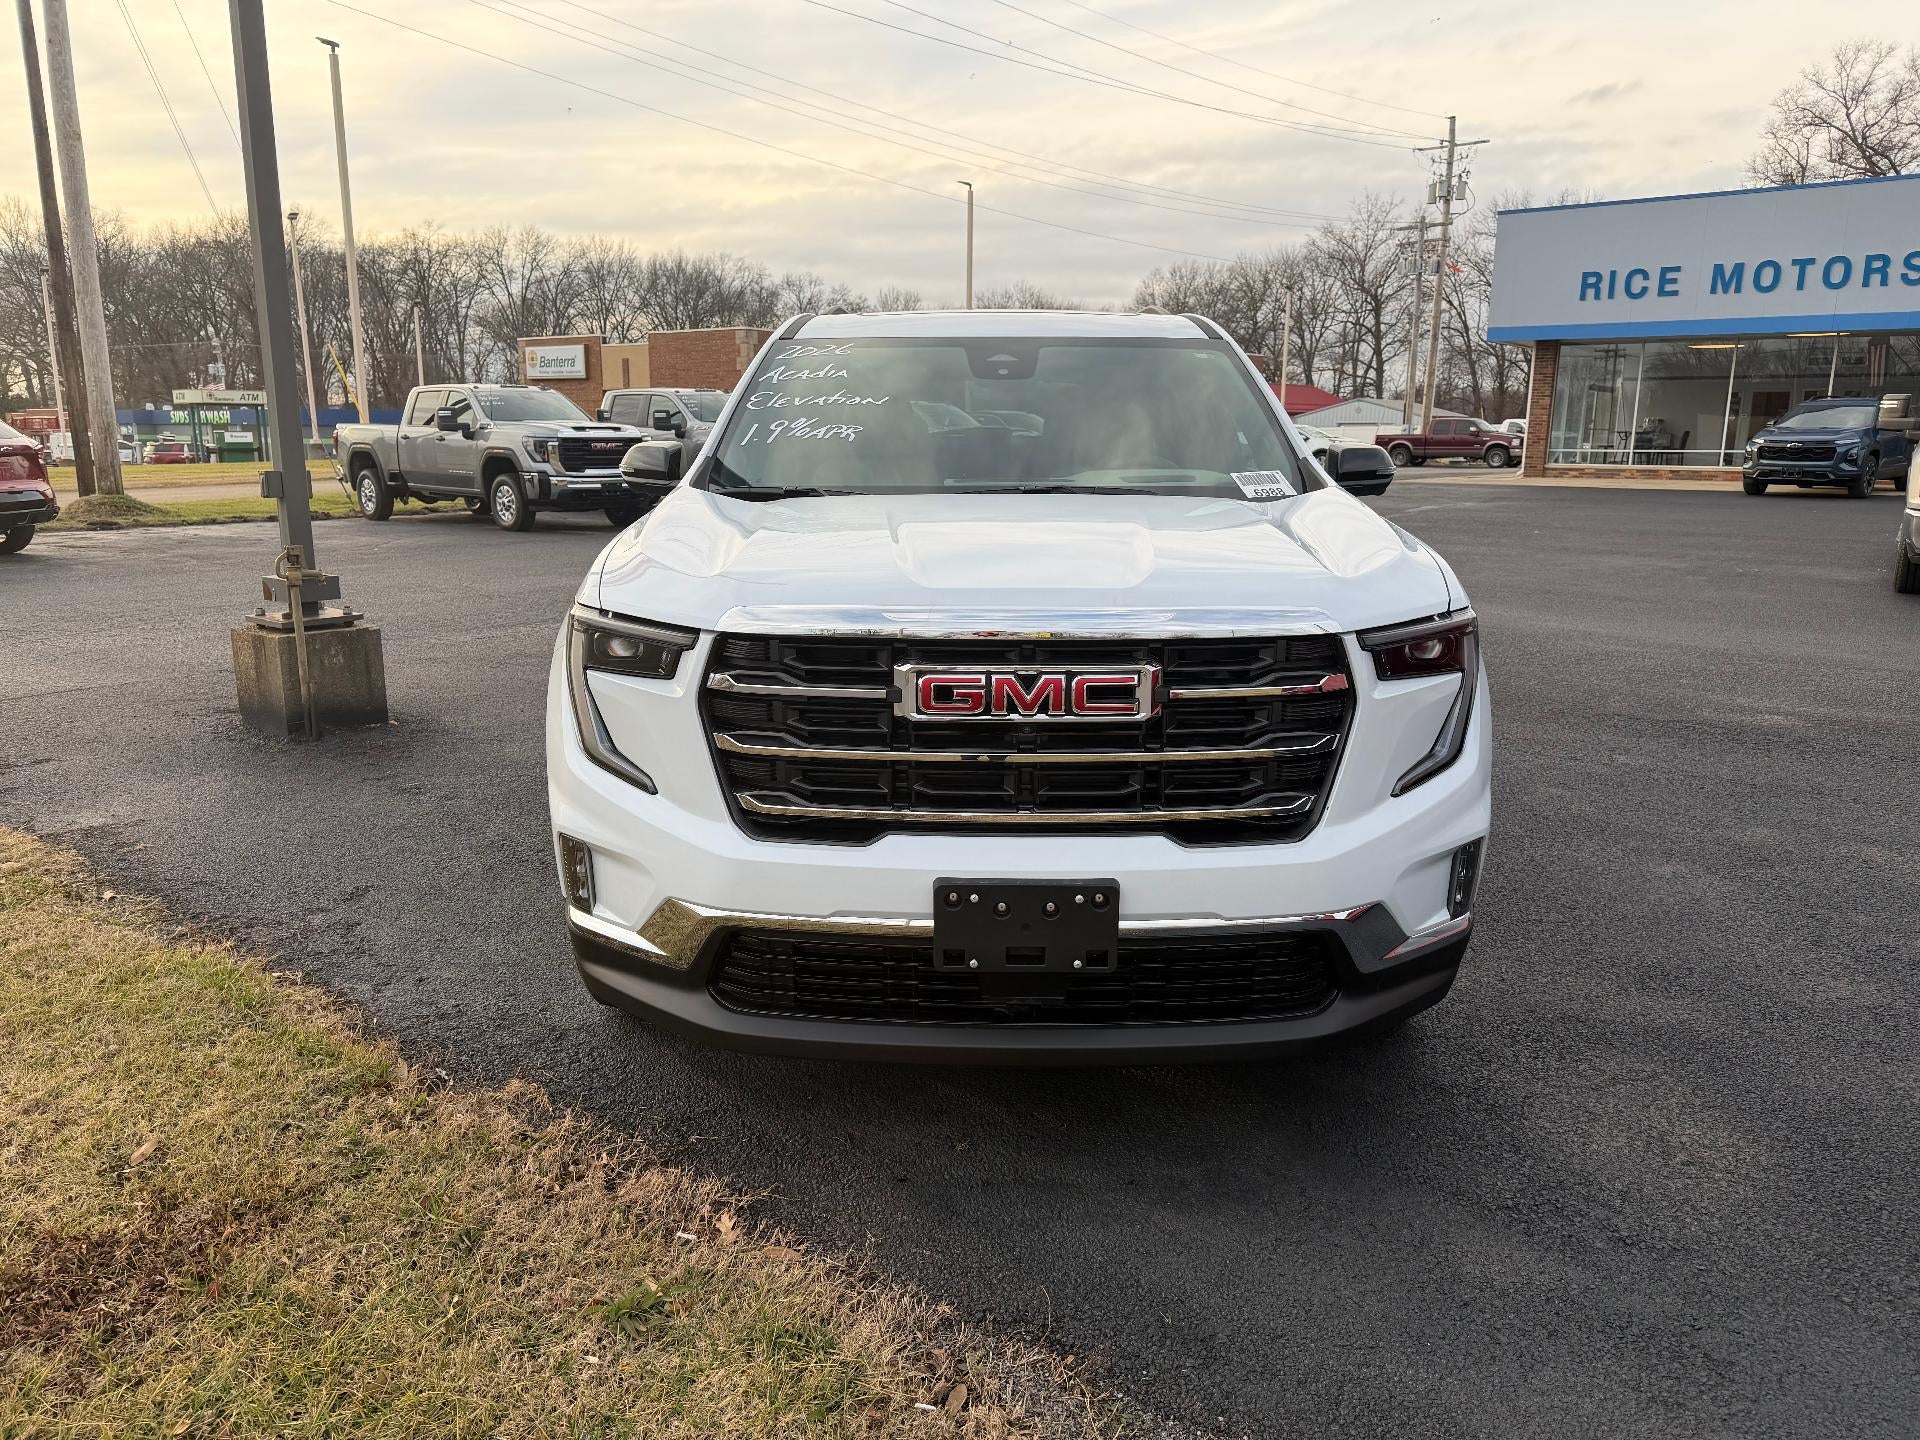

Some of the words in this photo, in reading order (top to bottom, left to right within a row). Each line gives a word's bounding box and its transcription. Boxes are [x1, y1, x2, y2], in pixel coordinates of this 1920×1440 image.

[1579, 265, 1682, 301] RICE
[1709, 250, 1920, 295] MOTORS
[775, 343, 854, 359] 2026
[539, 355, 576, 368] Banterra
[240, 393, 259, 402] ATM
[170, 410, 189, 424] SUDS
[1253, 487, 1286, 497] 6988
[918, 674, 1139, 715] GMC
